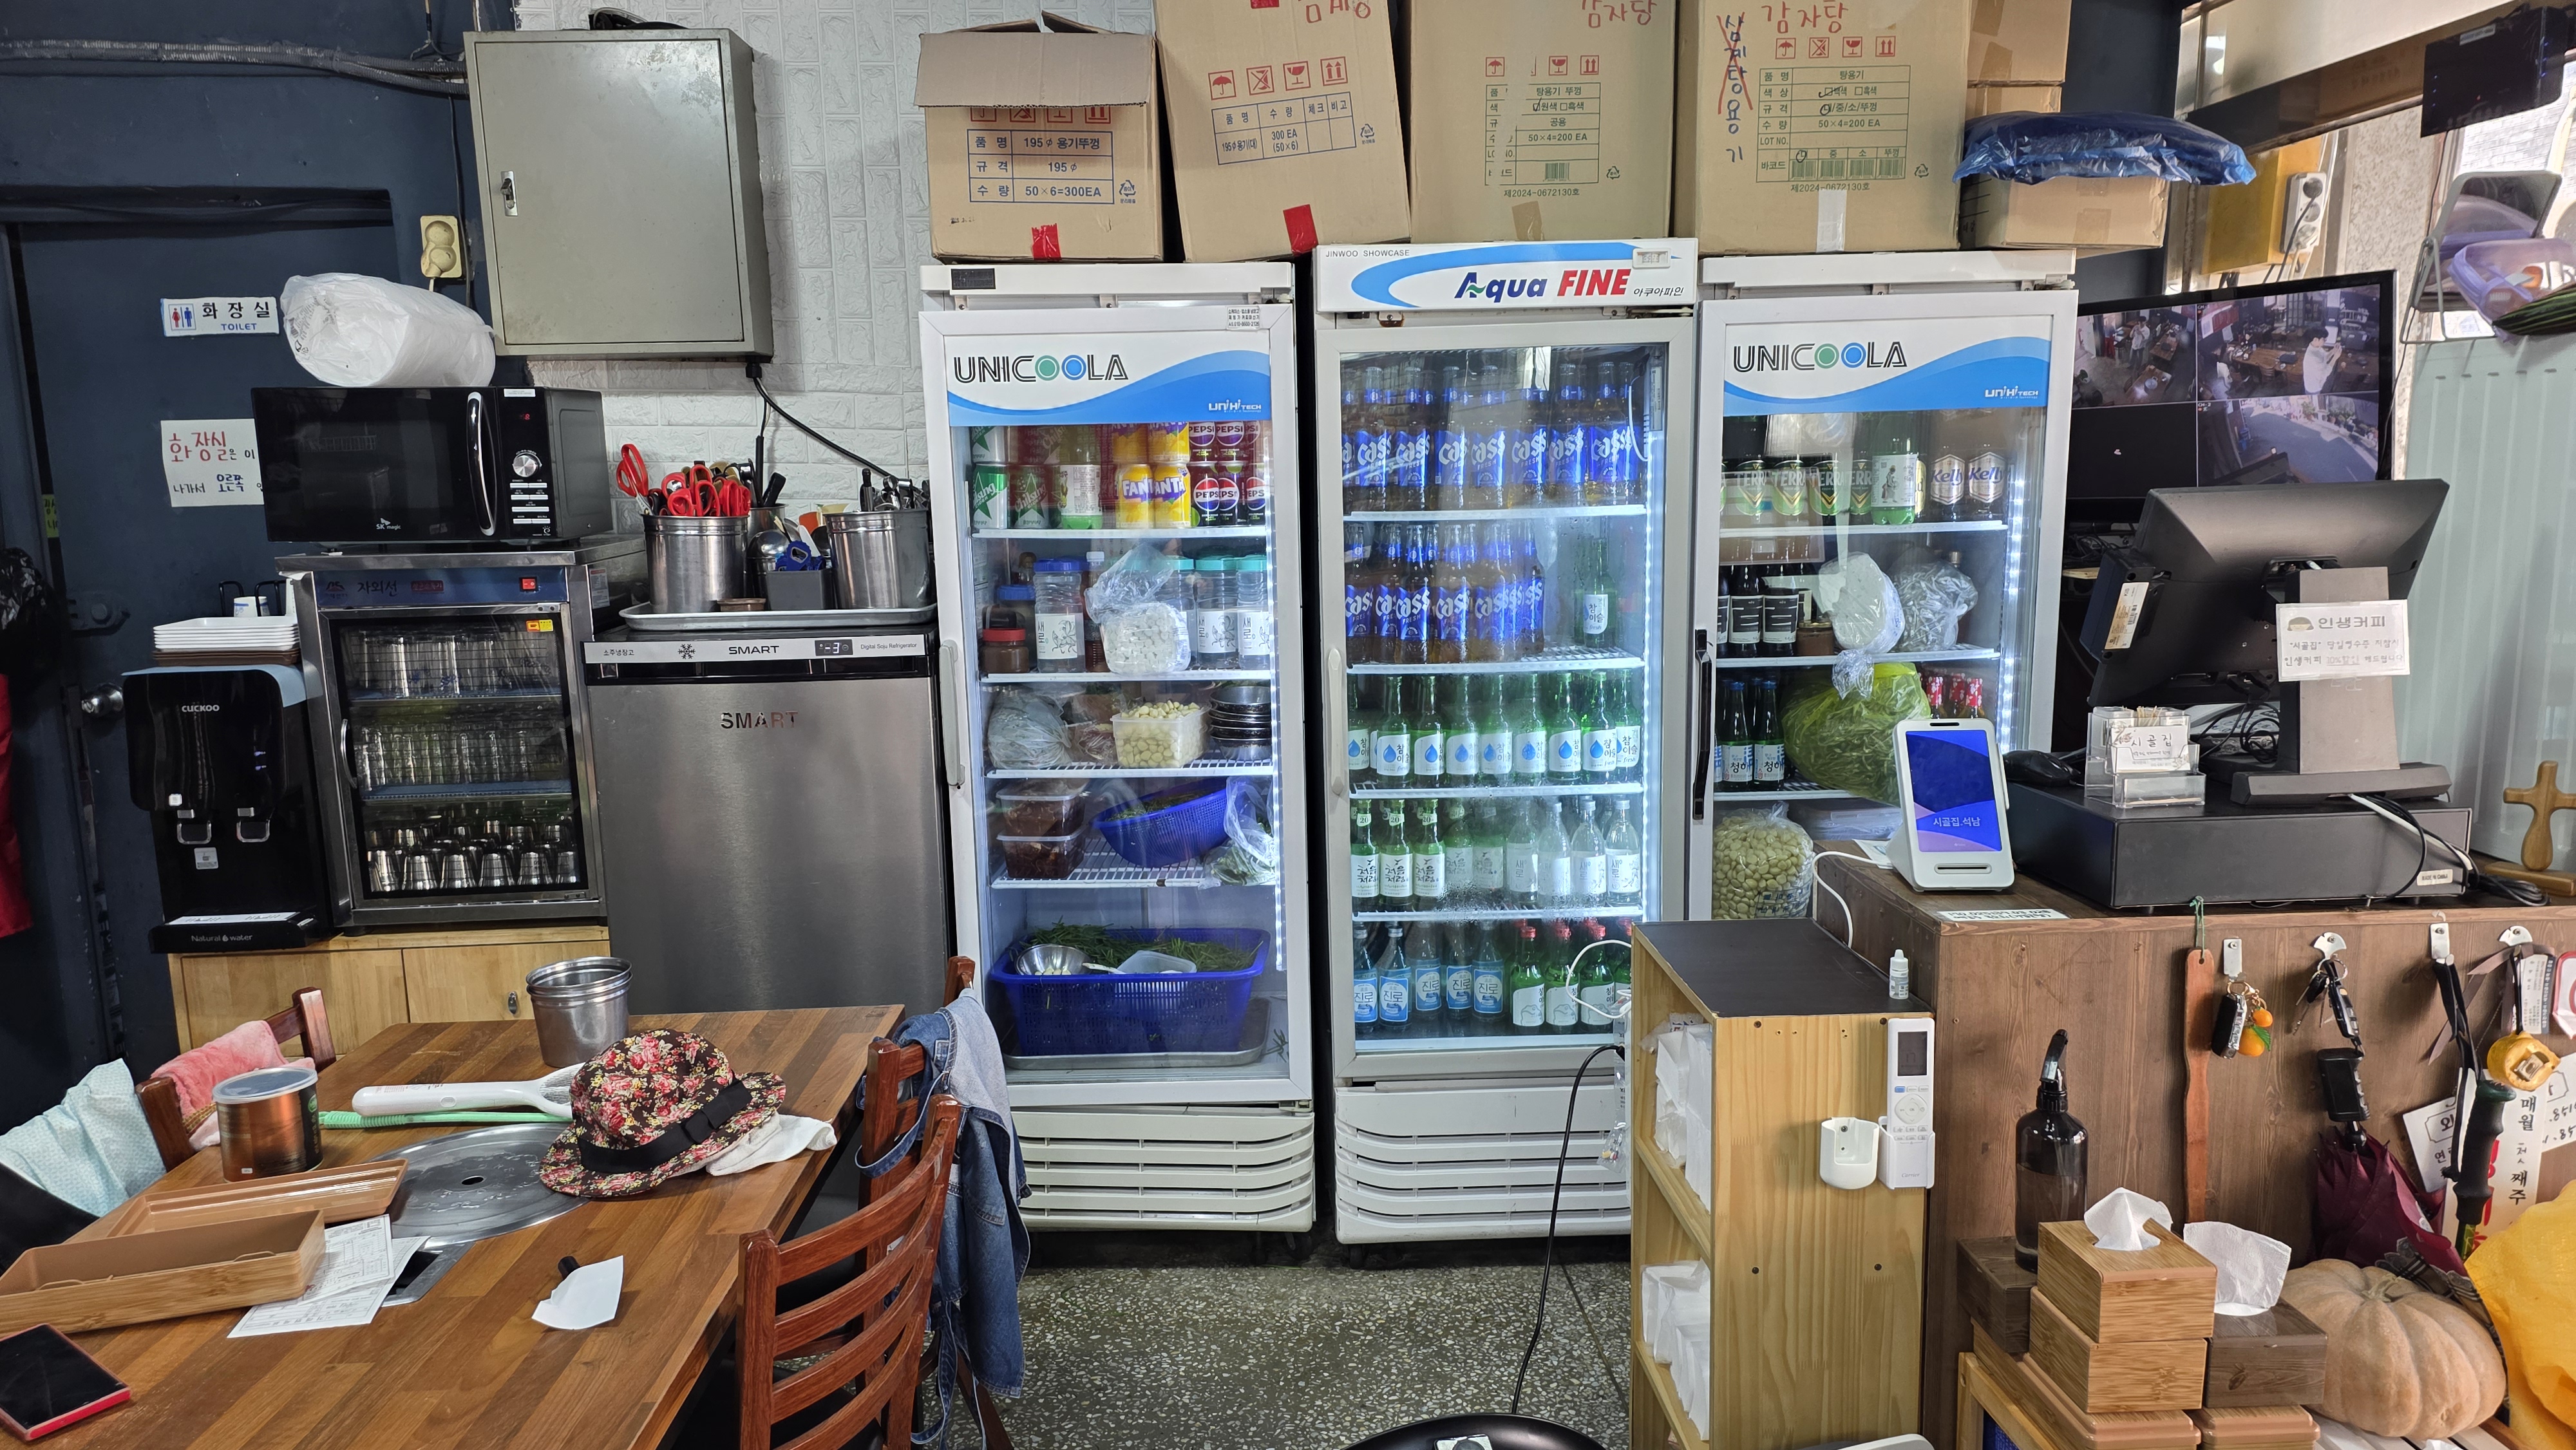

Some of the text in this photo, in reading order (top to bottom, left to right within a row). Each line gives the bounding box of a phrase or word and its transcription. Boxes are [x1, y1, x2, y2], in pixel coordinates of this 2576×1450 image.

[1762, 2, 1848, 34] 감자탕
[1839, 70, 1864, 80] 탕용기
[1536, 86, 1582, 96] 탕용기 뚜껑
[1863, 86, 1877, 96] 흑색
[1309, 100, 1348, 115] 체크 비고
[1540, 102, 1557, 111] 원색
[1567, 102, 1584, 111] 흑색
[1549, 117, 1567, 127] 공용
[1867, 118, 1880, 127] EA
[1271, 128, 1298, 140] 300 EA
[1575, 133, 1587, 141] EA
[1024, 137, 1043, 148] 195
[1056, 137, 1100, 149] 용기뚜껑
[1760, 137, 1789, 146] LOT NO.
[1884, 148, 1900, 158] 뚜껑
[1048, 162, 1067, 173] 195
[1761, 160, 1786, 170] 바코드
[1504, 188, 1580, 198] 제2024-0672130호
[1325, 249, 1410, 258] JINWOO SHOWCASE
[1454, 268, 1685, 303] Aqua FINE 아쿠아파인
[220, 323, 257, 331] TOILET
[1732, 341, 1908, 373] UNICOOLA
[953, 354, 1128, 384] UNICOOLA
[1189, 424, 1215, 433] PEPSI
[1933, 468, 1963, 486] Kelly
[1969, 467, 2003, 484] Kelly
[173, 482, 206, 494] 나가서
[216, 474, 244, 493] 오른쪽
[1155, 477, 1186, 494] ANTA
[357, 579, 399, 598] 자외선
[1396, 589, 1430, 620] Cass
[1402, 614, 1421, 625] FRESH
[2318, 616, 2385, 630] 인생커피
[728, 645, 780, 655] SMART
[876, 643, 888, 651] Soju
[889, 641, 918, 650] Refrigerator
[603, 648, 635, 657] 소주냉장고
[2284, 655, 2322, 666] 인생커피
[181, 704, 220, 713] CUCKOO
[720, 711, 799, 730] SMART
[2131, 733, 2172, 748] 시골집
[1390, 815, 1400, 824] 20
[1422, 815, 1431, 824] 20
[1385, 864, 1405, 875] 처음
[1416, 863, 1435, 875] 처음
[1385, 874, 1406, 883] 처럼
[1416, 874, 1435, 883] 처럼
[1422, 979, 1440, 993] 진로
[1452, 978, 1471, 991] 진로
[1478, 983, 1499, 995] 진로
[1354, 992, 1374, 1003] 진로
[1383, 991, 1403, 1003] 진로
[2518, 1095, 2537, 1132] 매월
